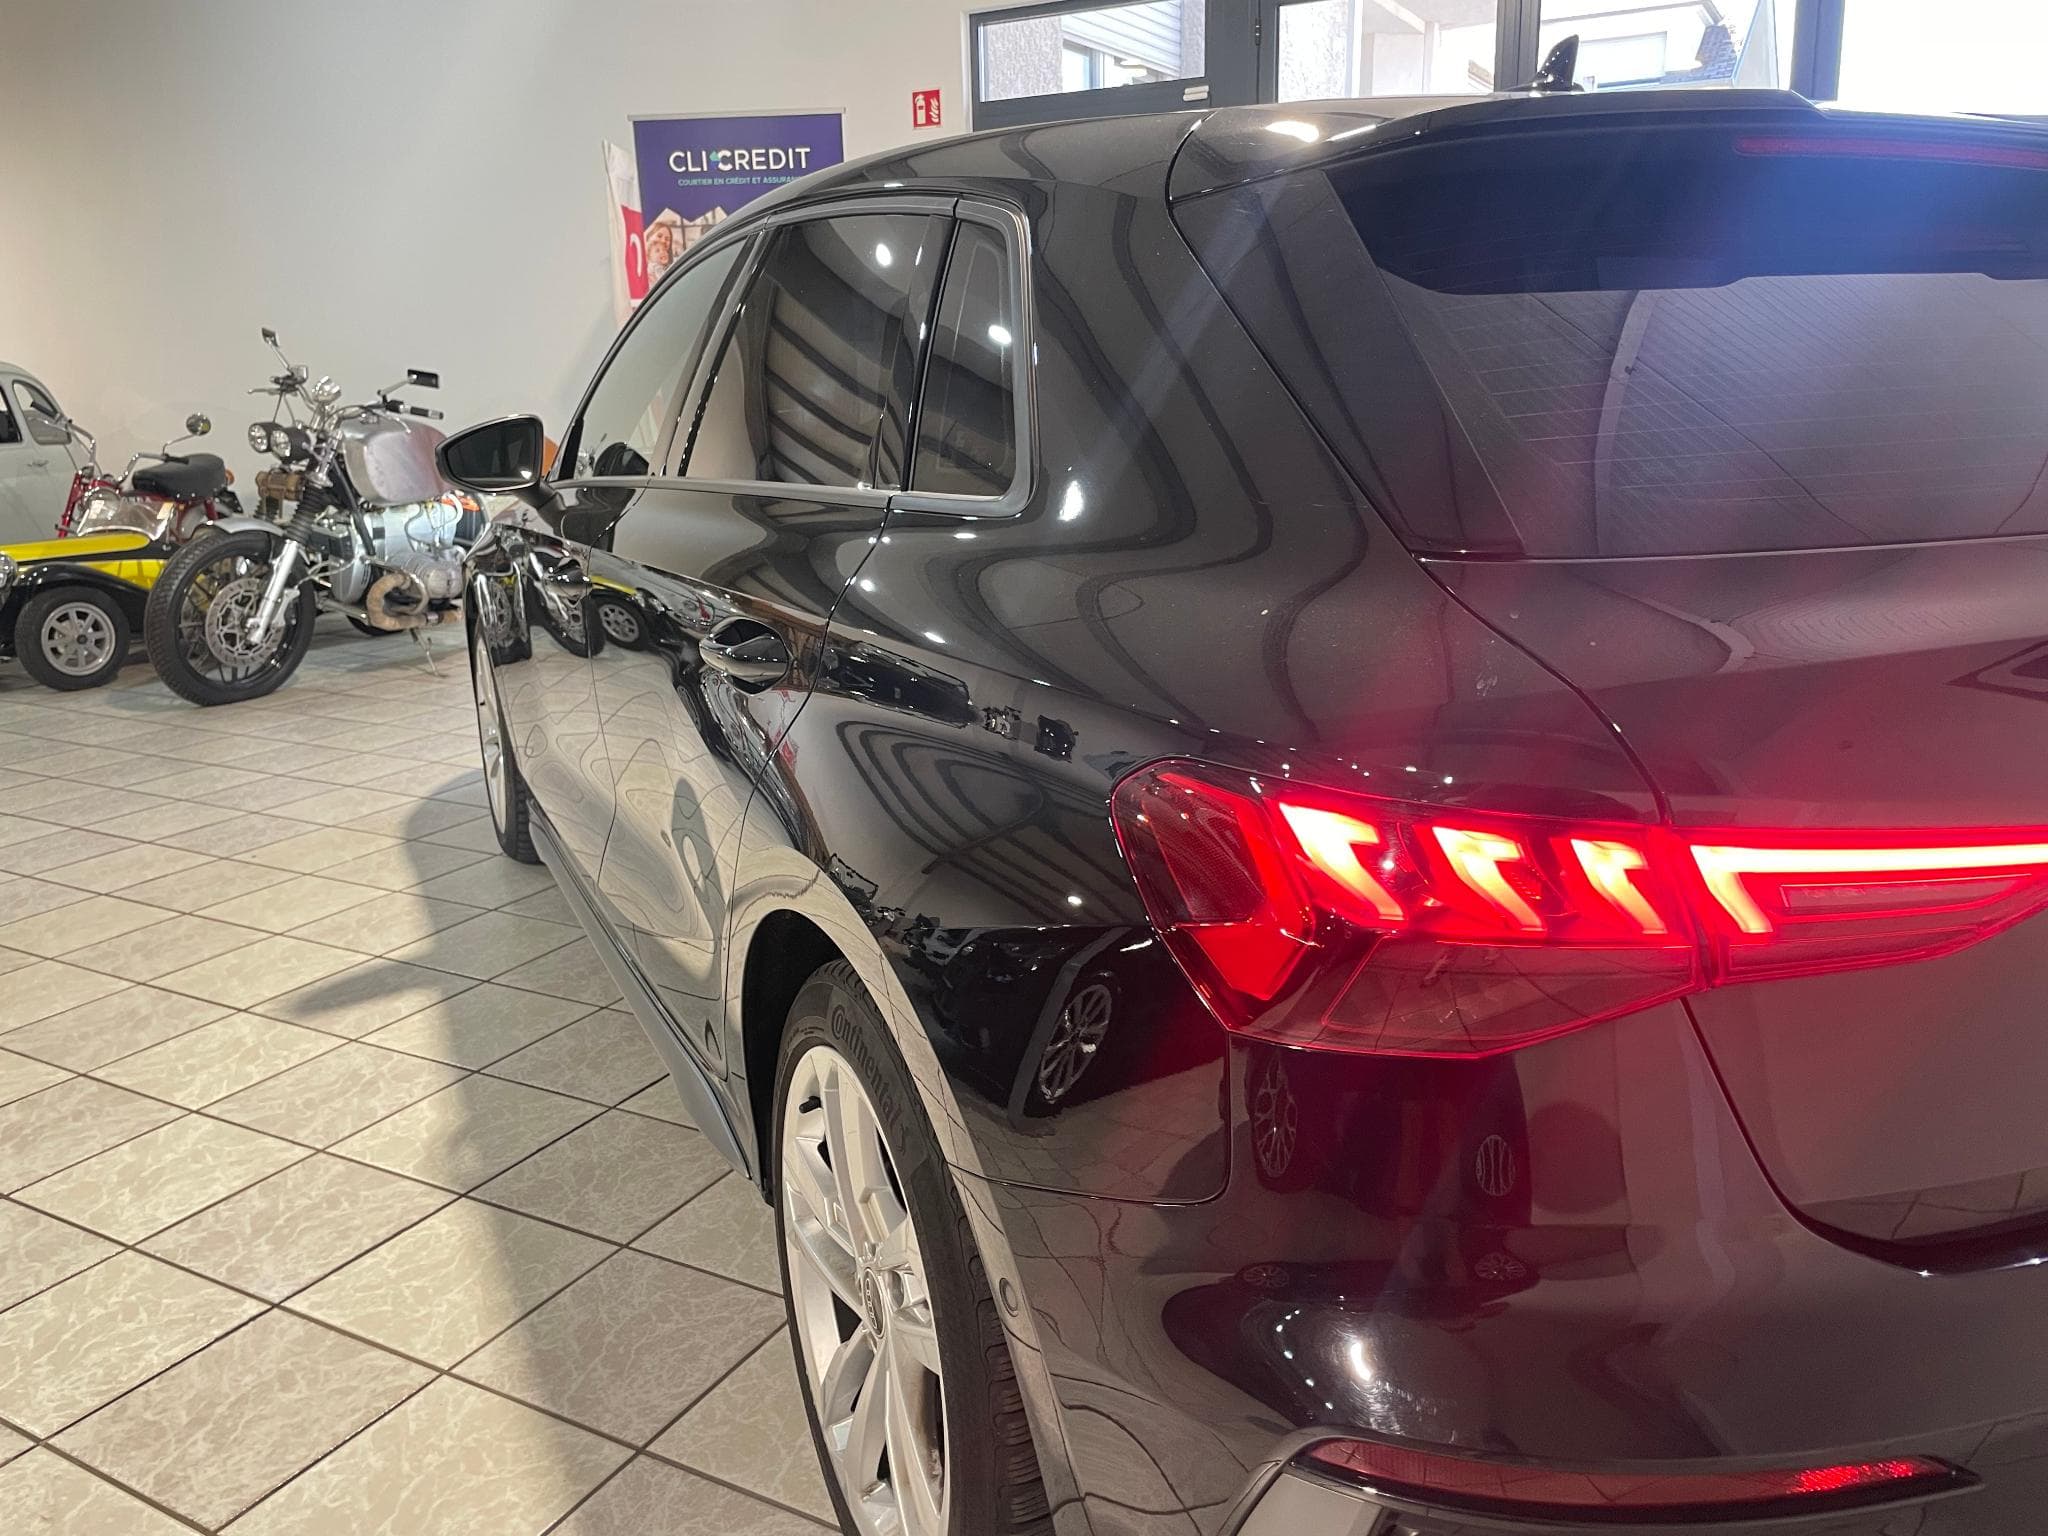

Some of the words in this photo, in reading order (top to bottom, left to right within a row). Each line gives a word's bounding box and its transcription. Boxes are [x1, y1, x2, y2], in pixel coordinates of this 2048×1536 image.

[678, 178, 712, 187] COURTIER
[713, 177, 724, 186] EN
[752, 176, 761, 185] ET
